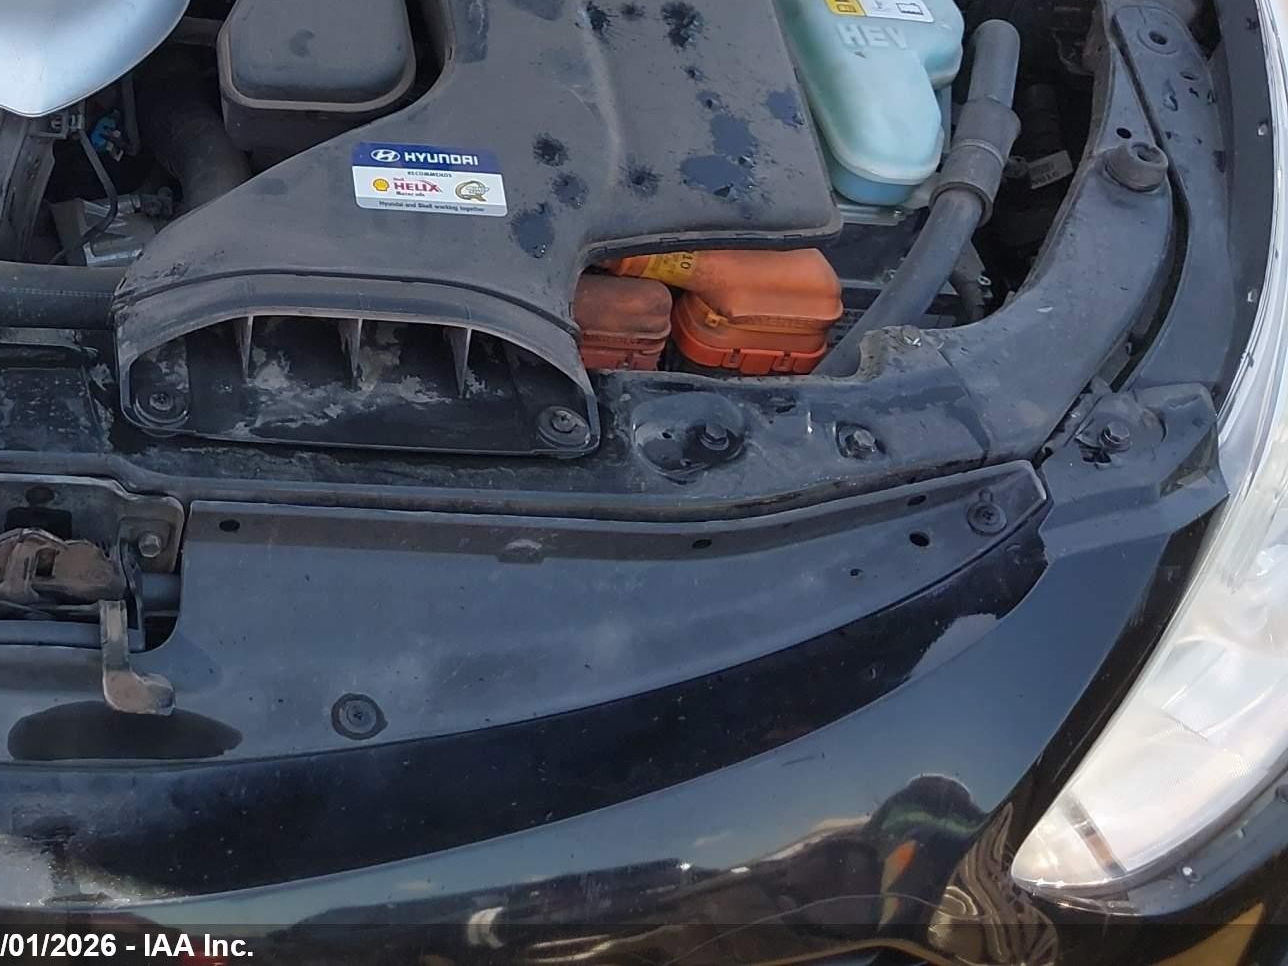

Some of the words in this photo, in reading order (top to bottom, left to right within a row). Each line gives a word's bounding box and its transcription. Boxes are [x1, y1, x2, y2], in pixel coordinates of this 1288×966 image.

[836, 22, 907, 50] HEV
[404, 152, 479, 166] HYUNDAI
[393, 181, 441, 193] HELIX
[379, 200, 404, 208] Hyundai
